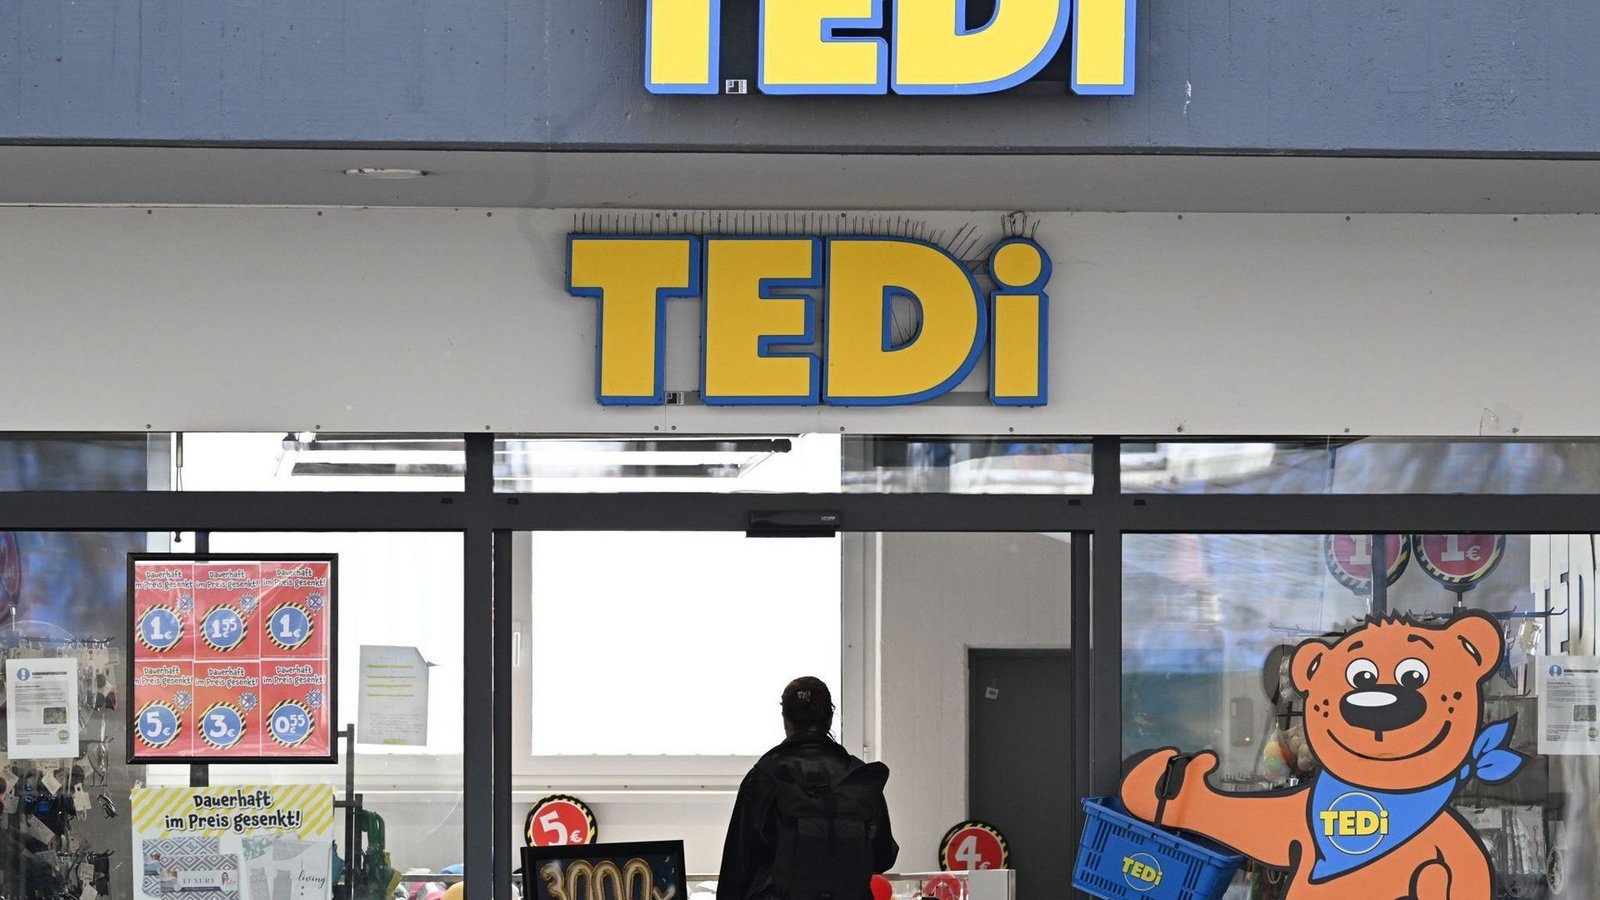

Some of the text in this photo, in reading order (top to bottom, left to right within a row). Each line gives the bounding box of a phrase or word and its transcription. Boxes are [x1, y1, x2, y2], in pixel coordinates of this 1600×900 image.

[566, 233, 1052, 406] TEDi
[146, 569, 183, 579] Dauerhaft
[209, 569, 246, 579] Dauerhaft
[144, 665, 180, 676] Dauerhaft
[207, 667, 245, 677] Dauerhaft
[275, 665, 313, 675] Dauerhaft
[141, 676, 162, 685] Preis
[195, 677, 259, 688] im Preis gesenkt!
[263, 676, 274, 685] im
[273, 675, 295, 685] Preis
[192, 790, 272, 808] Dauerhaft
[164, 809, 302, 832] im Preis gesenkt!
[1319, 809, 1389, 837] TEDi
[1122, 856, 1163, 887] TEDi
